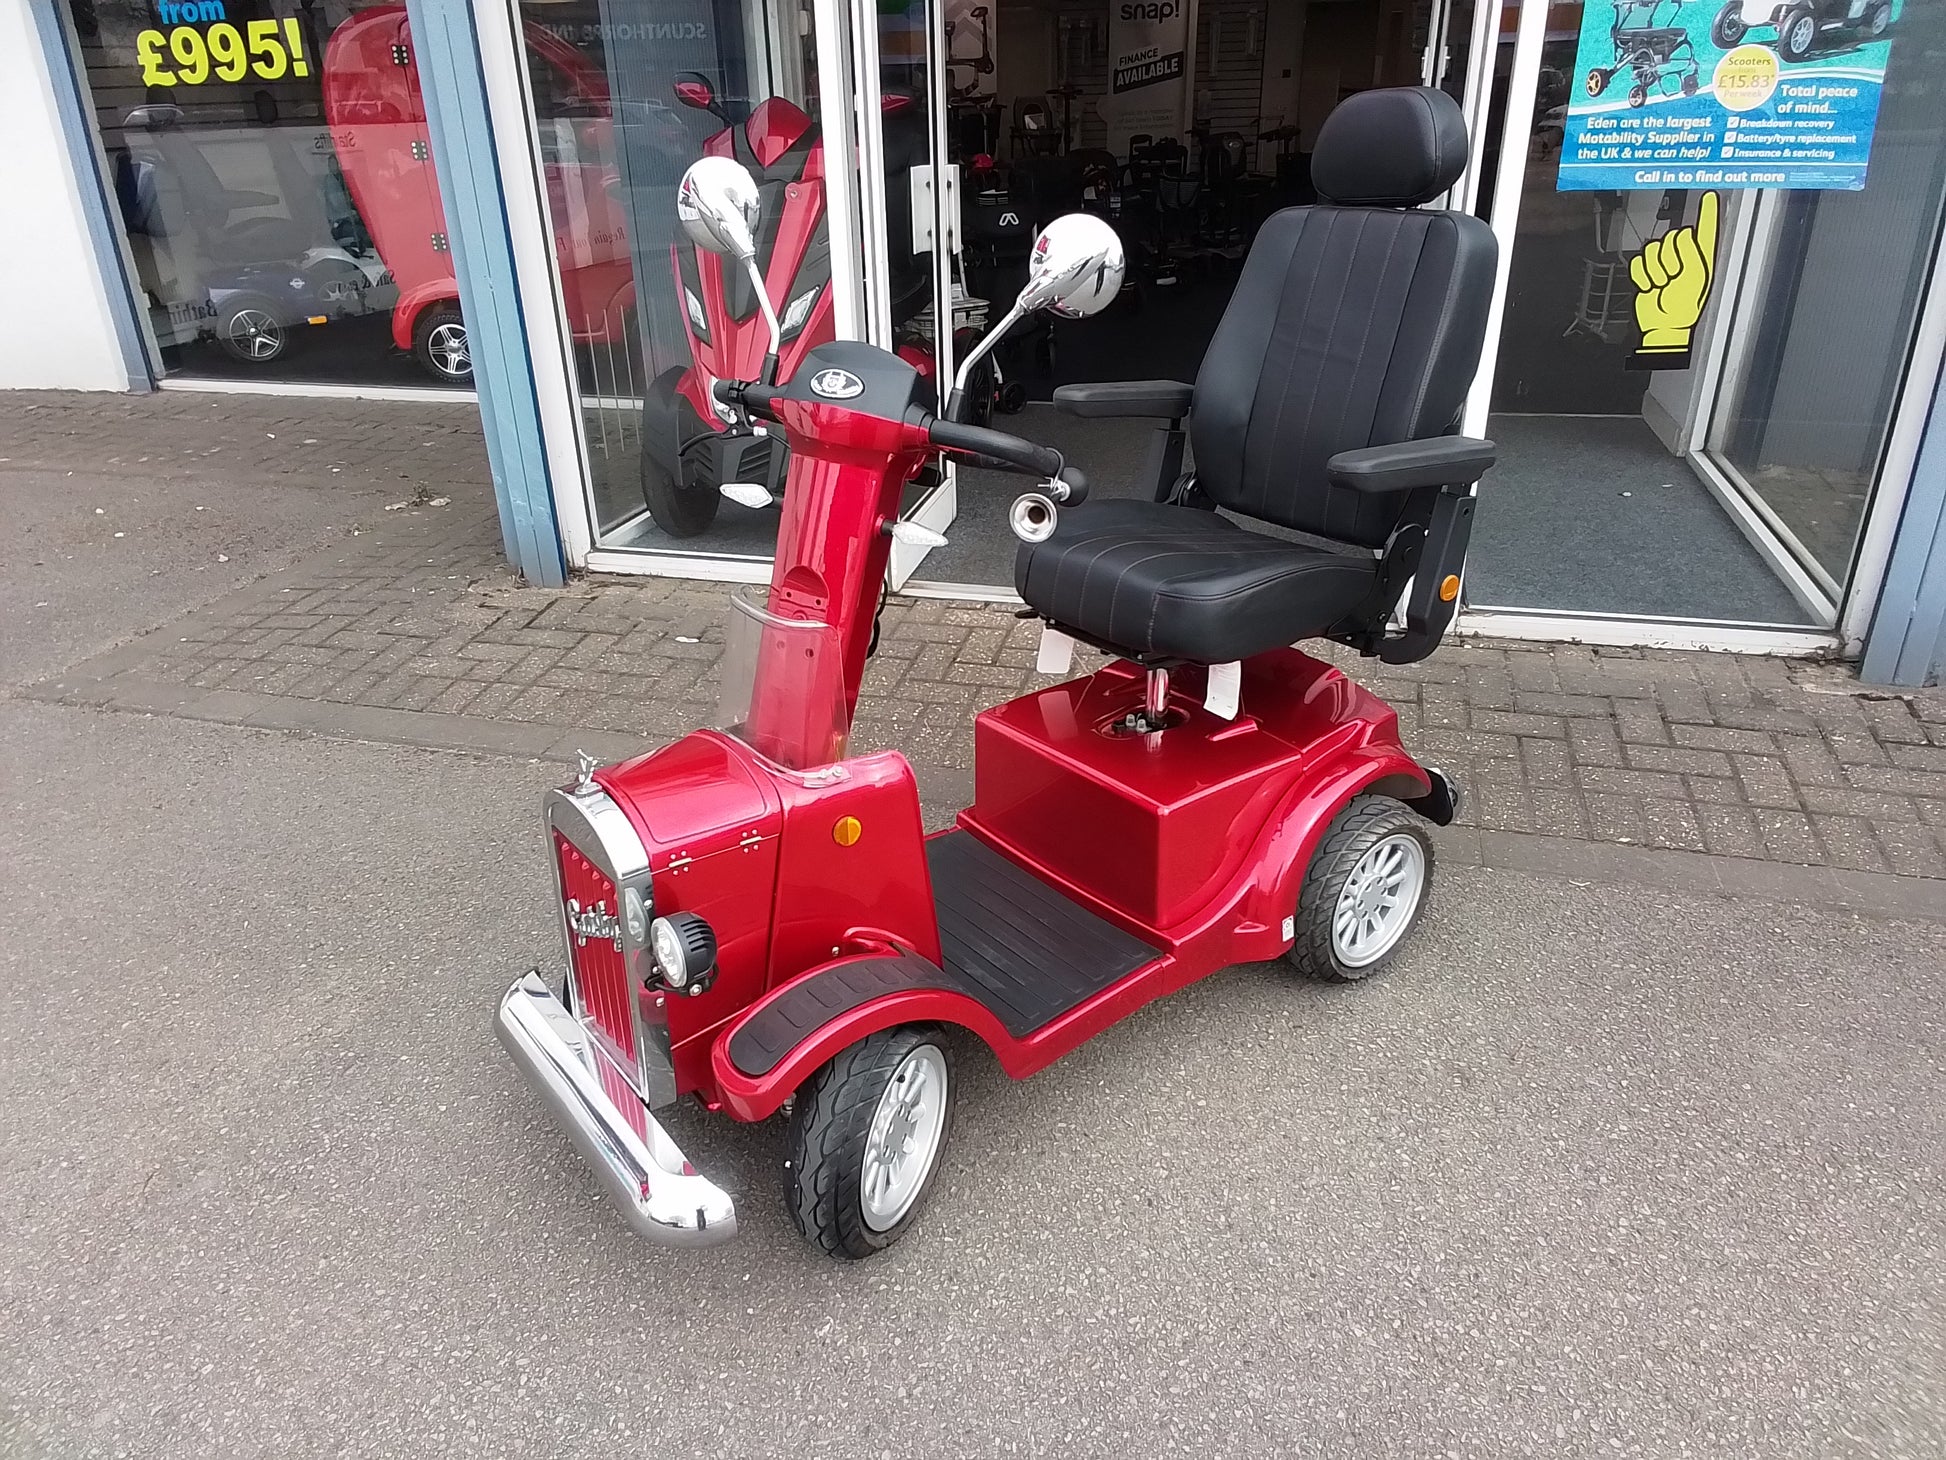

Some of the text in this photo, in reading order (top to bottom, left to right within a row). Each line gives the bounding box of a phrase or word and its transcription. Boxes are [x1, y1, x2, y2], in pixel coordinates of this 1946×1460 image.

[159, 0, 226, 25] from
[1120, 0, 1181, 24] snap!
[137, 17, 309, 87] £995!
[1119, 47, 1159, 67] FINANCE
[1728, 56, 1772, 66] Scooters
[1116, 57, 1179, 87] AVAILABLE
[1780, 84, 1859, 99] Total peace
[1777, 101, 1793, 114] of
[1586, 115, 1712, 130] Eden are the largest
[1740, 119, 1835, 130] Breakdown recovery
[1578, 131, 1715, 146] Motability Supplier in
[1737, 134, 1857, 145] Battery/tyre replacement
[1577, 146, 1712, 160] the UK & we can help!
[1734, 148, 1836, 160] Insurance & servicing
[1634, 170, 1660, 183] Call
[1662, 170, 1676, 182] in
[1678, 171, 1693, 182] to
[1695, 169, 1723, 182] find
[1725, 171, 1749, 182] out
[1751, 172, 1786, 183] more
